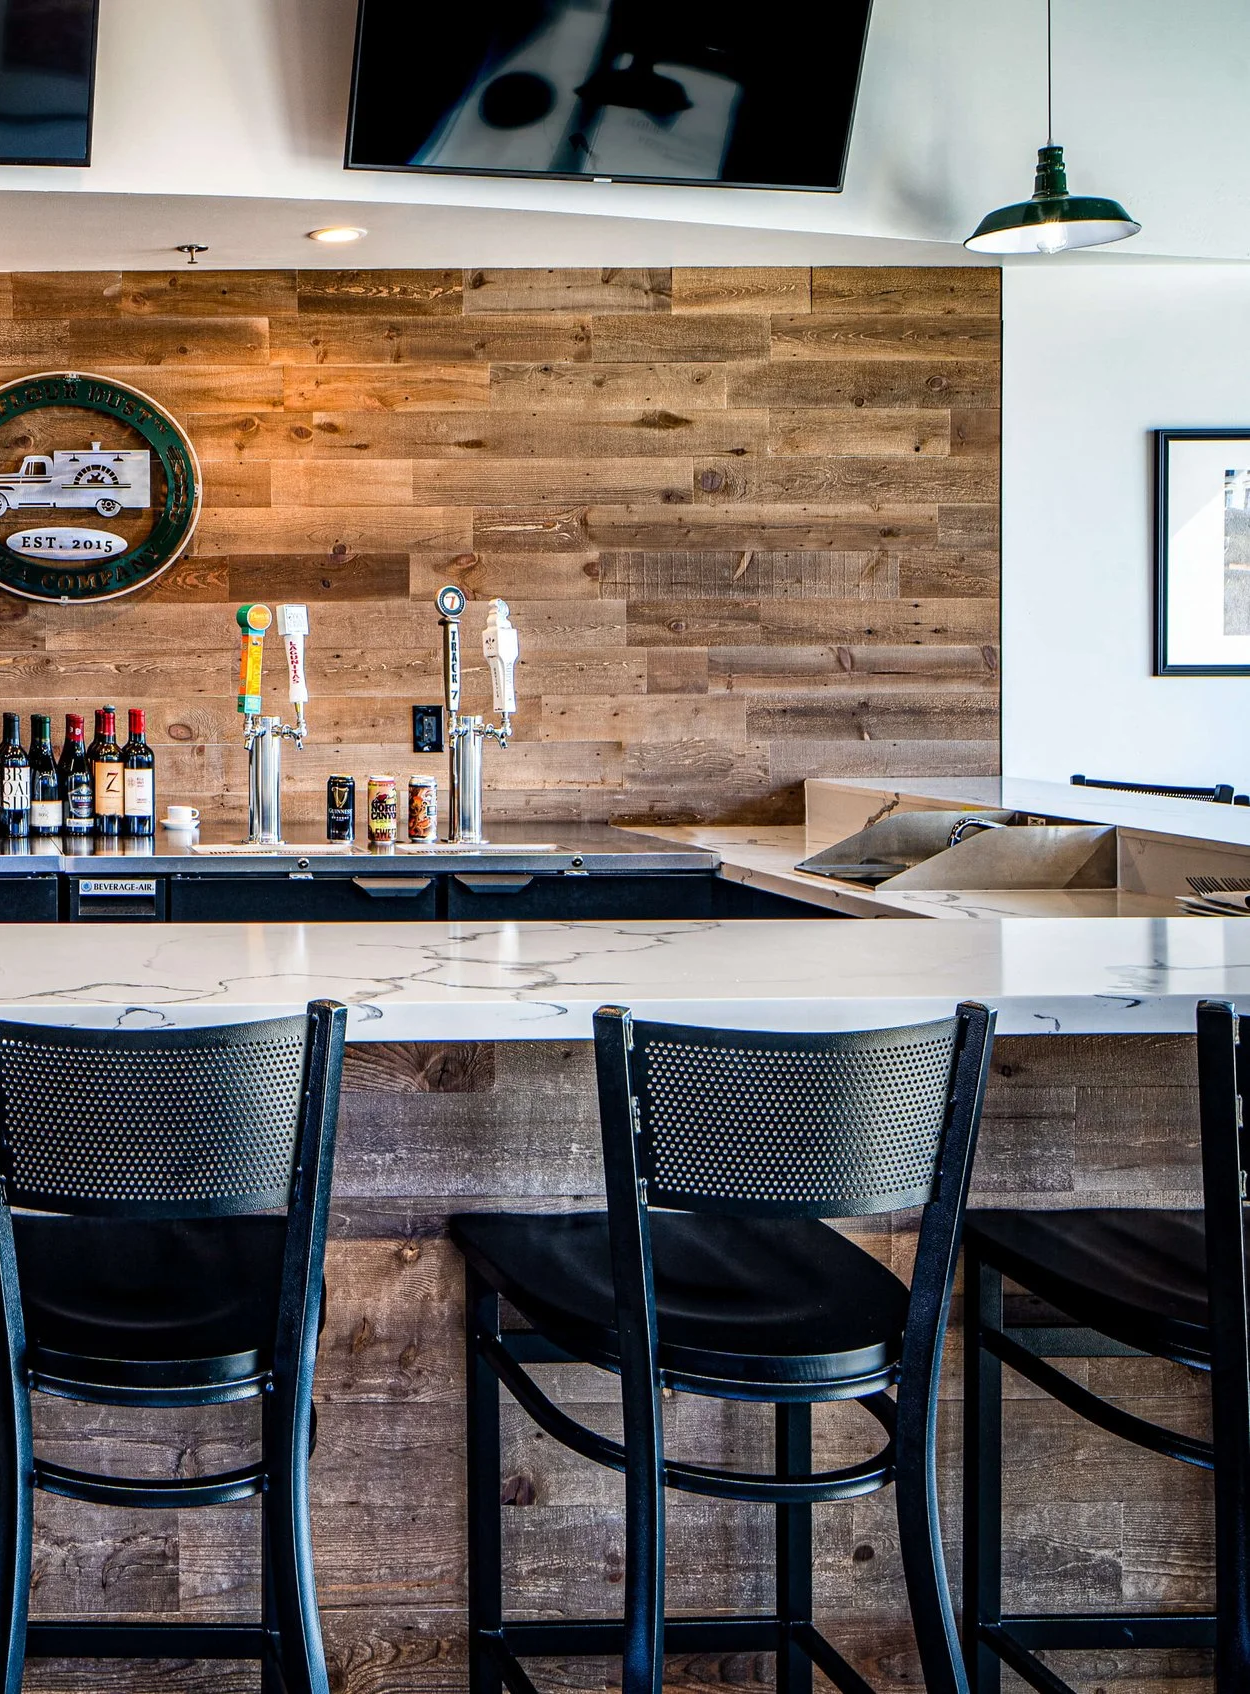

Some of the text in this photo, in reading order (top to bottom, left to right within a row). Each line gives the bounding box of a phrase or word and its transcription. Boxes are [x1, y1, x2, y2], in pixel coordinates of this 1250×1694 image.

[21, 536, 113, 553] EST. 2015
[450, 631, 458, 684] TRACK
[4, 767, 22, 781] BR
[105, 772, 120, 793] Z
